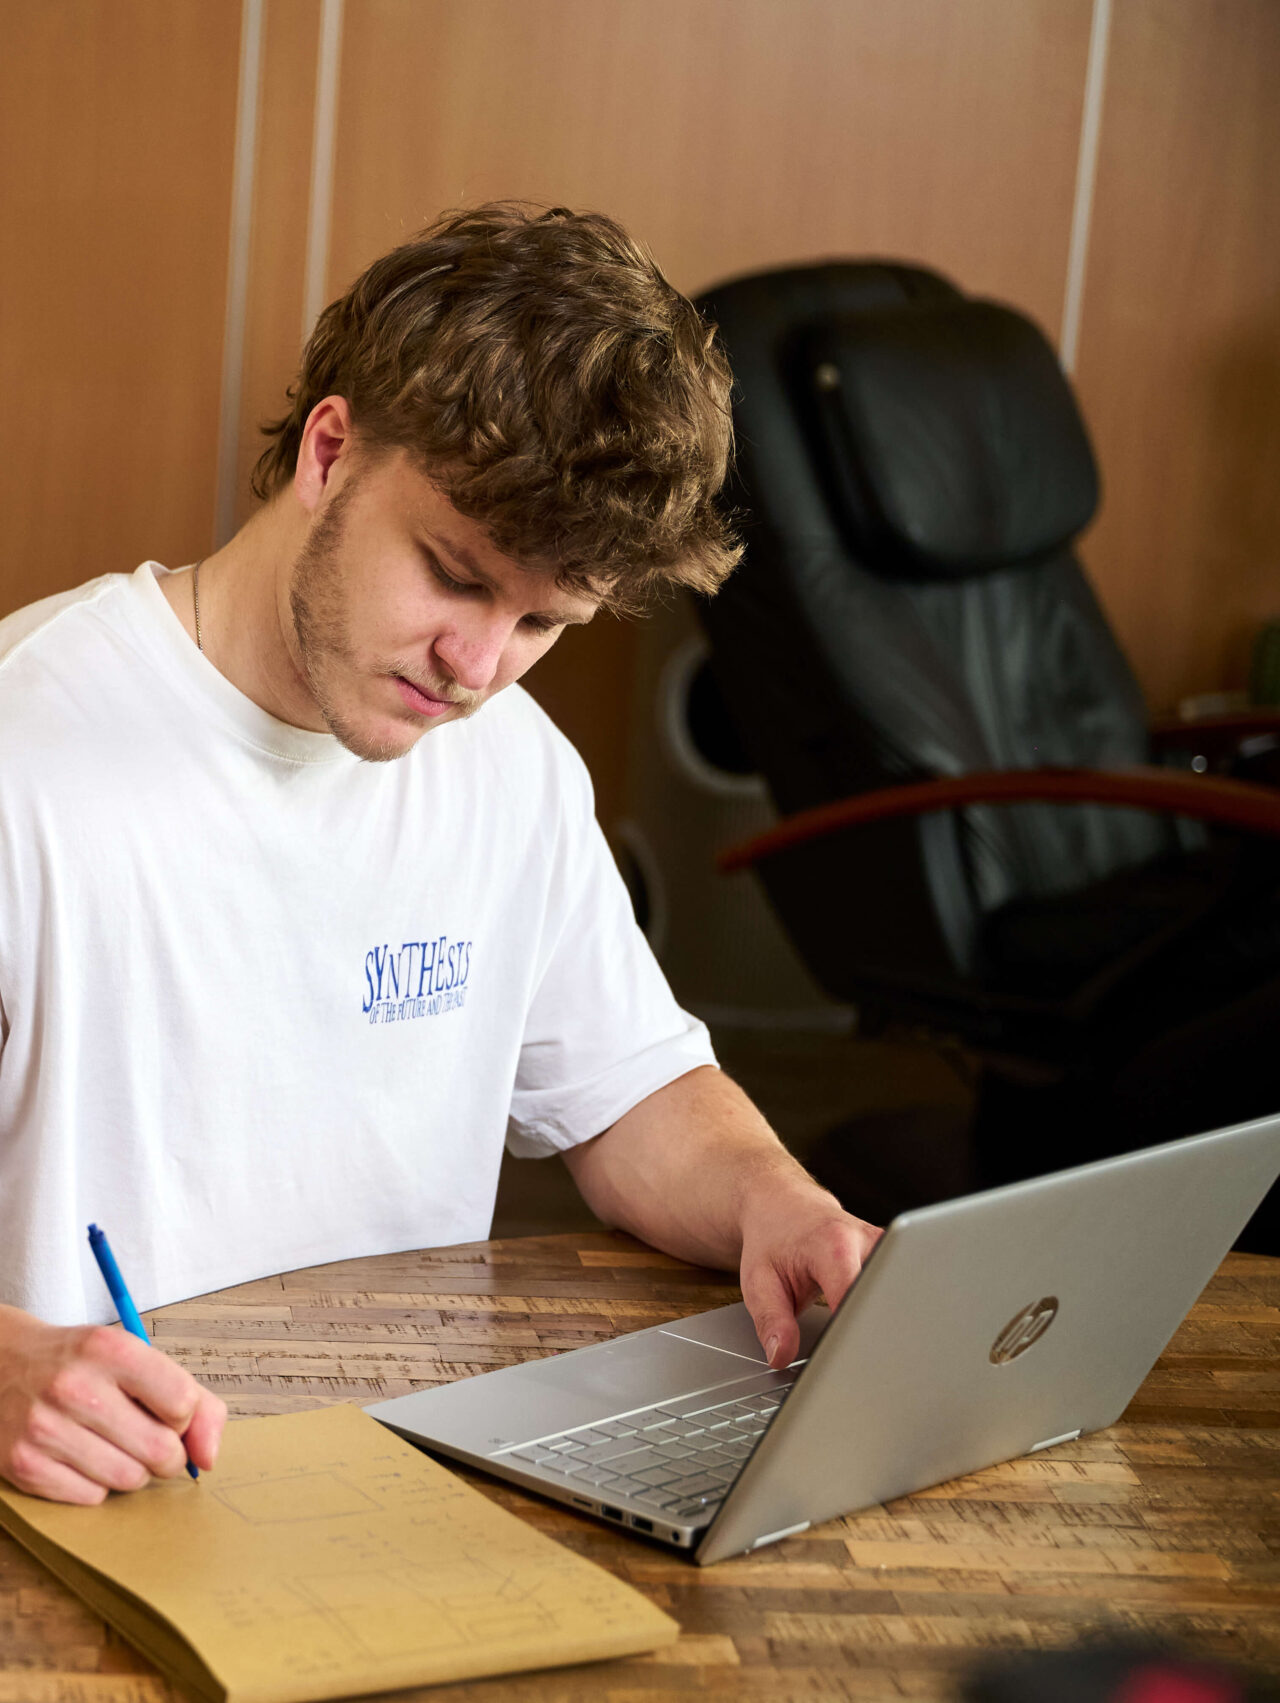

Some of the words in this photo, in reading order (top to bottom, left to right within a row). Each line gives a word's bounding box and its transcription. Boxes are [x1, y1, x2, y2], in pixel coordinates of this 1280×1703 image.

[362, 936, 472, 1013] SYNTHESIS
[369, 1003, 380, 1024] OF
[380, 1002, 397, 1023] THE
[397, 997, 426, 1020] FUTURE
[426, 994, 442, 1016] AND
